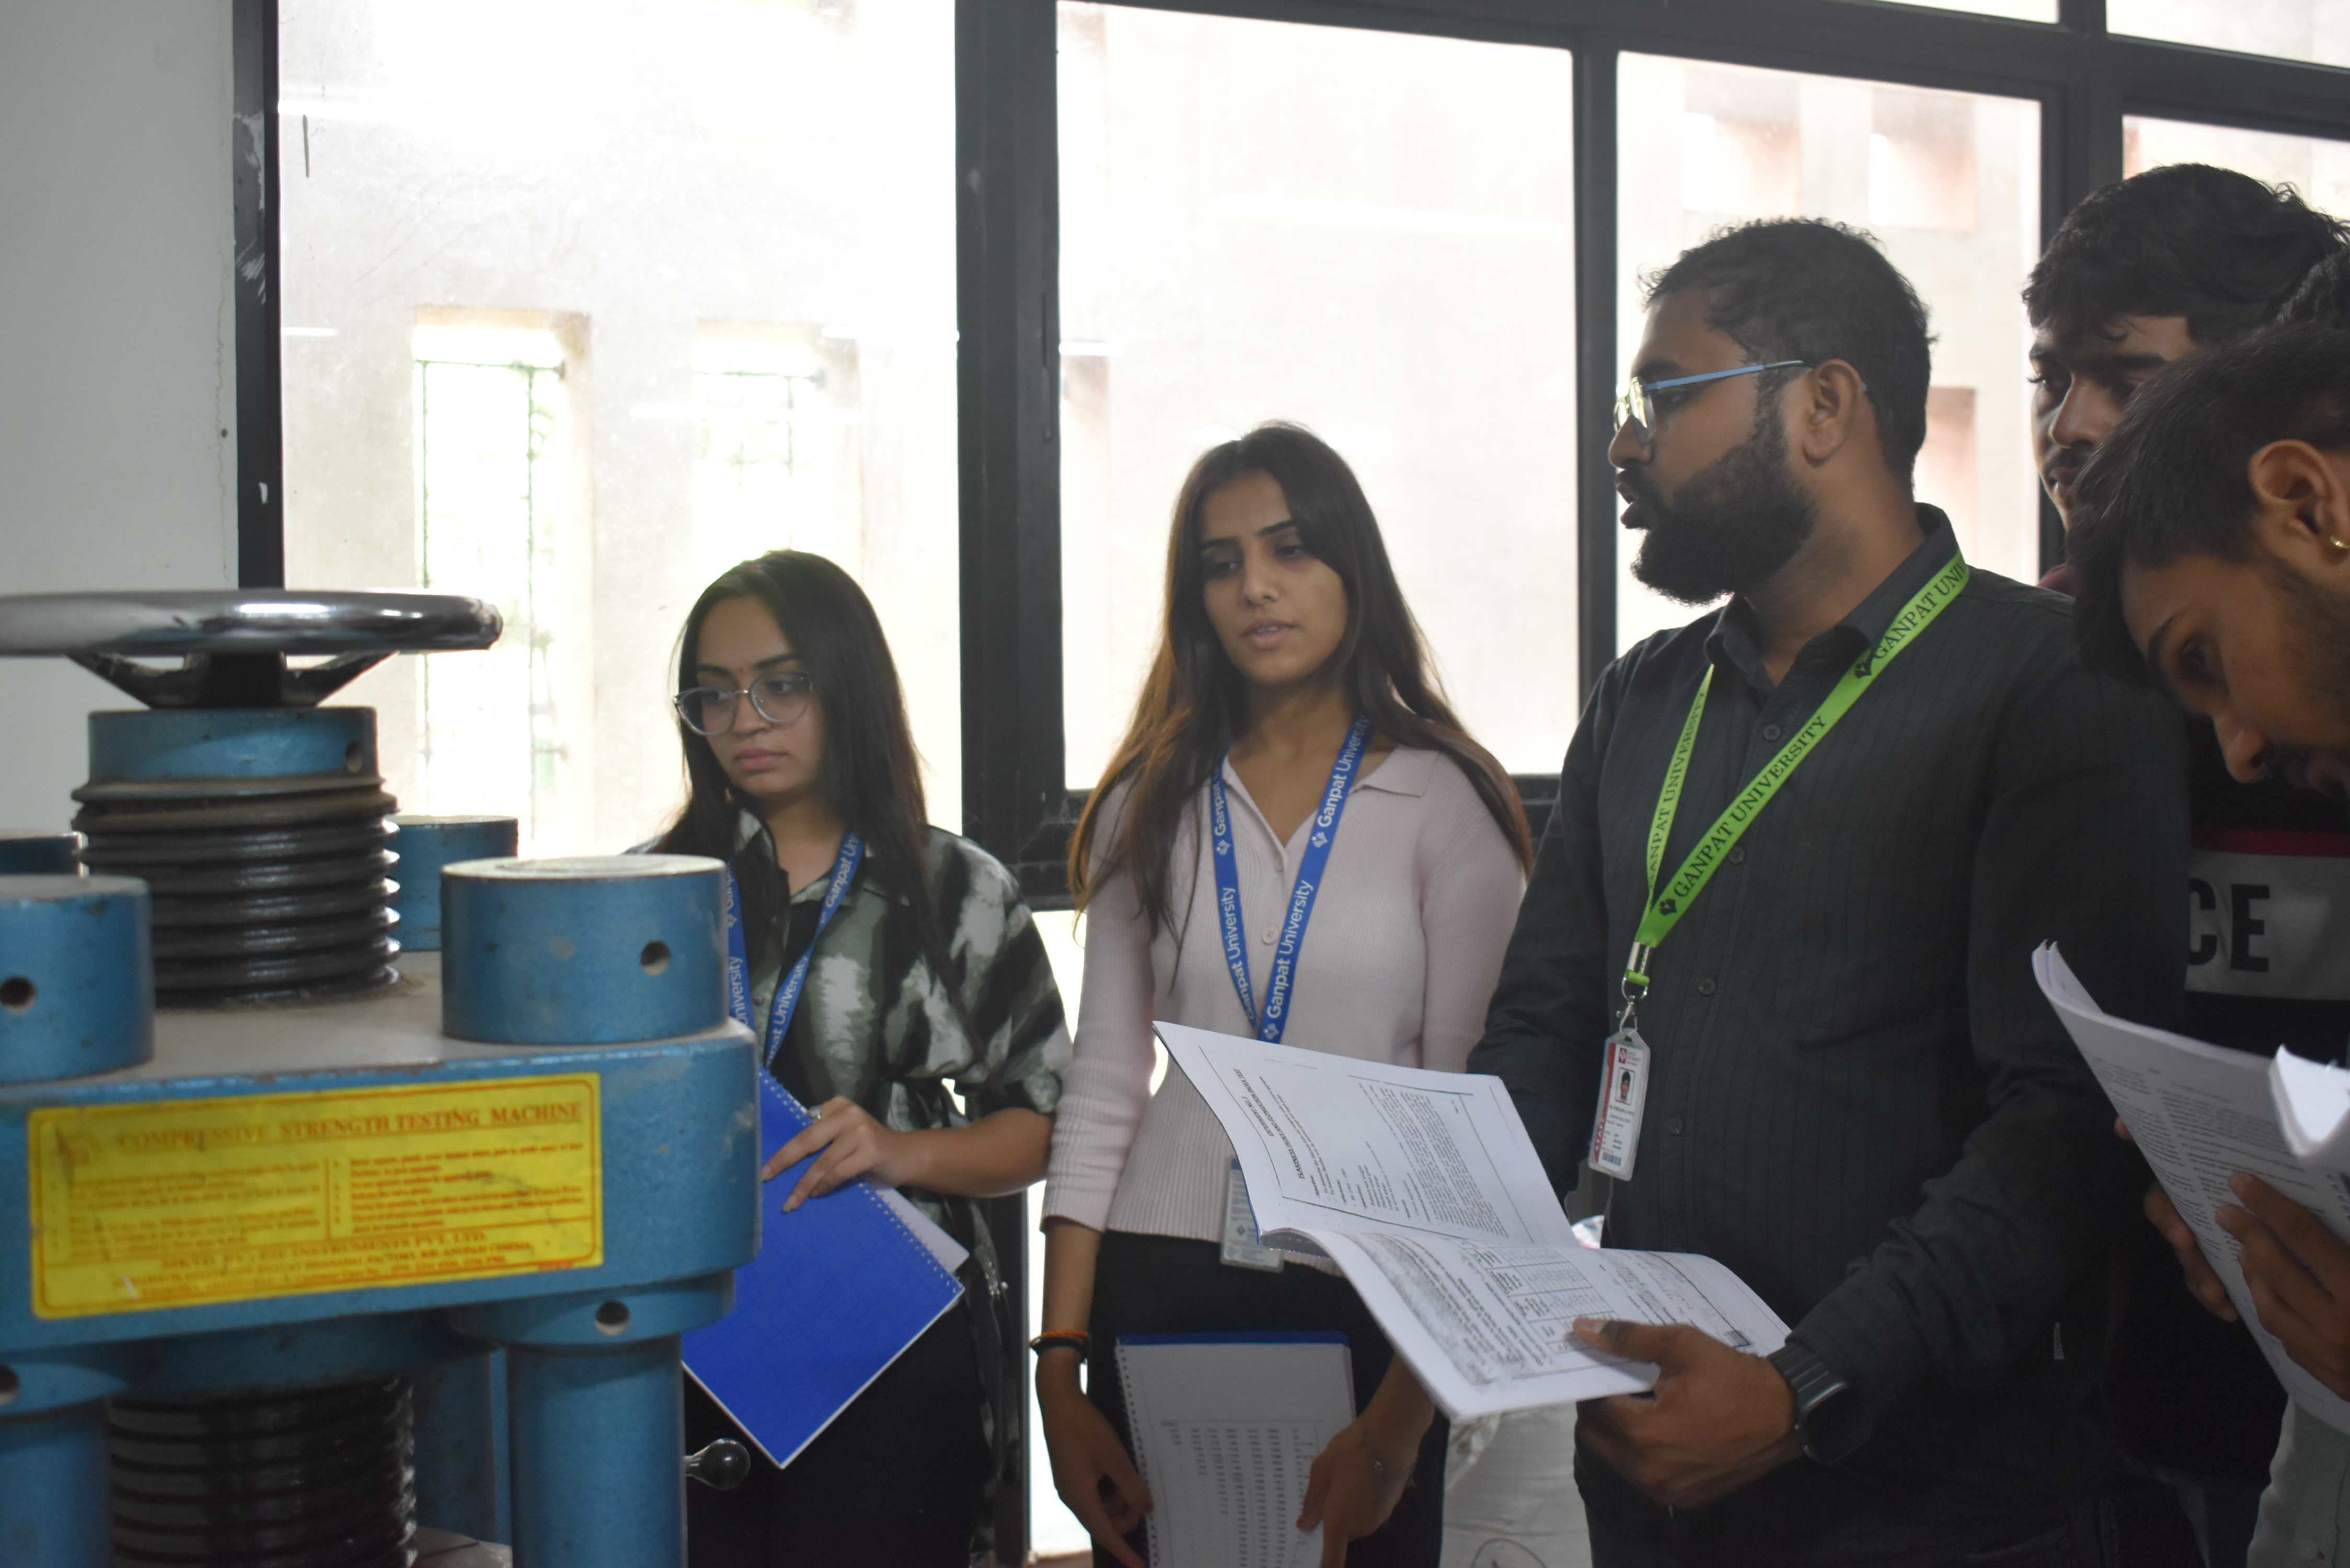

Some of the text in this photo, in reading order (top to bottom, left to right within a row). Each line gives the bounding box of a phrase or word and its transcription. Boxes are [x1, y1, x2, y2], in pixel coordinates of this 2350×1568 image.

[1873, 592, 1938, 660] GANPAT
[1317, 714, 1370, 828] Ganpat University
[1665, 691, 1706, 800] UNIVERSITY
[1674, 715, 1827, 898] GANPAT UNIVERSITY
[826, 857, 853, 908] Ganpat
[773, 955, 809, 1025] University
[1220, 886, 1254, 1021] Ganpat University
[1266, 880, 1314, 1019] Ganpat University
[280, 1115, 389, 1139] STRENGTH
[397, 1109, 479, 1131] TESTING
[491, 1102, 581, 1124] MACHINE
[1287, 1148, 1304, 1179] FLAKINESS
